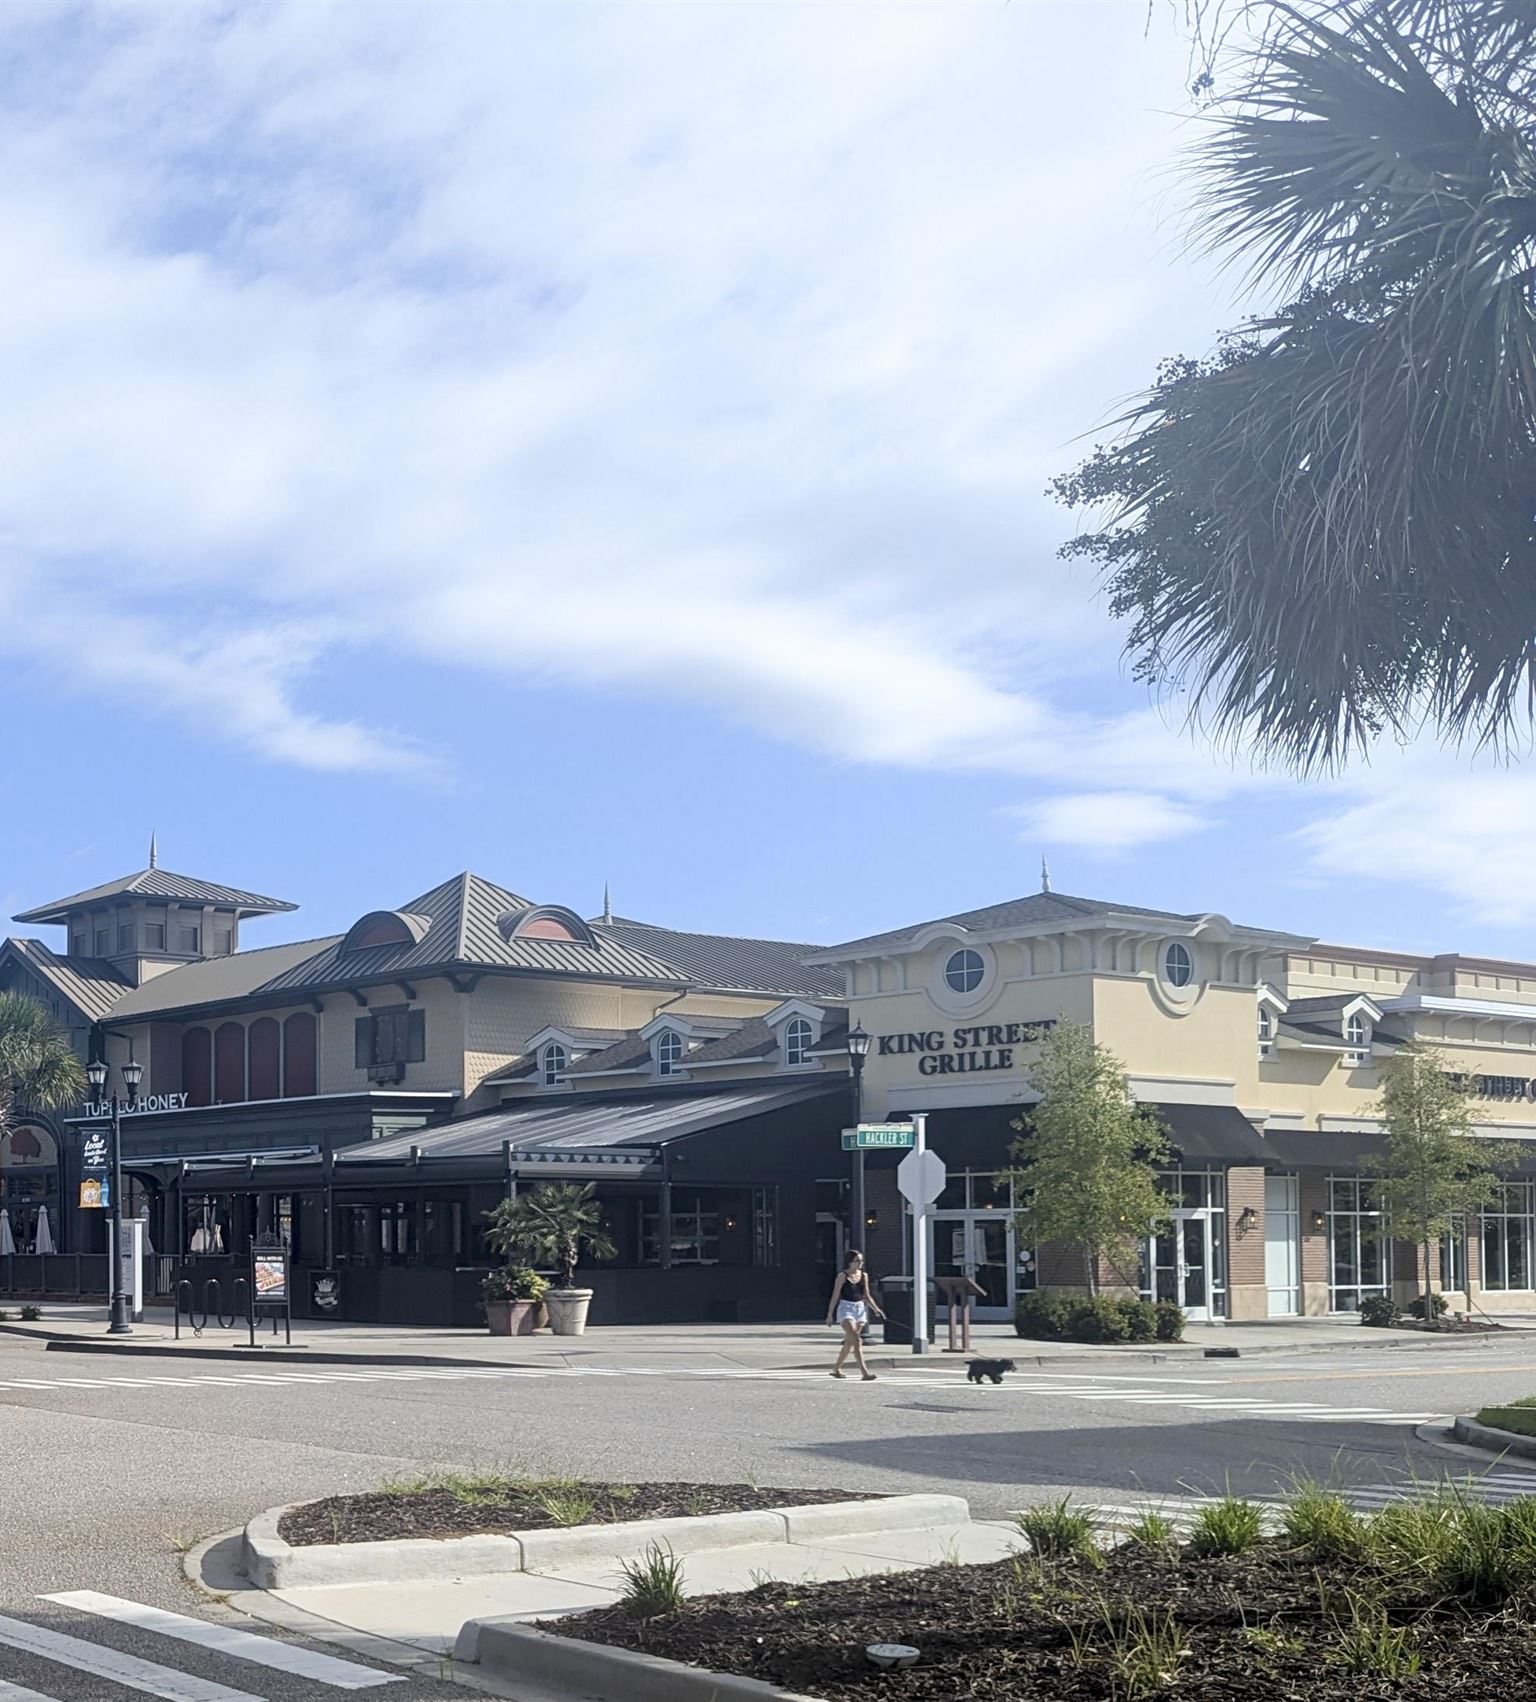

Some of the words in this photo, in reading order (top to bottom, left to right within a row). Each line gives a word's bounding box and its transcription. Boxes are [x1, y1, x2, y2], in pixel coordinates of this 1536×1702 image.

[877, 1031, 944, 1055] KING
[953, 1019, 1057, 1048] STREET
[919, 1049, 1013, 1075] GRILLE
[138, 1093, 188, 1112] HONEY
[866, 1132, 897, 1144] HACKLER
[899, 1132, 908, 1145] ST
